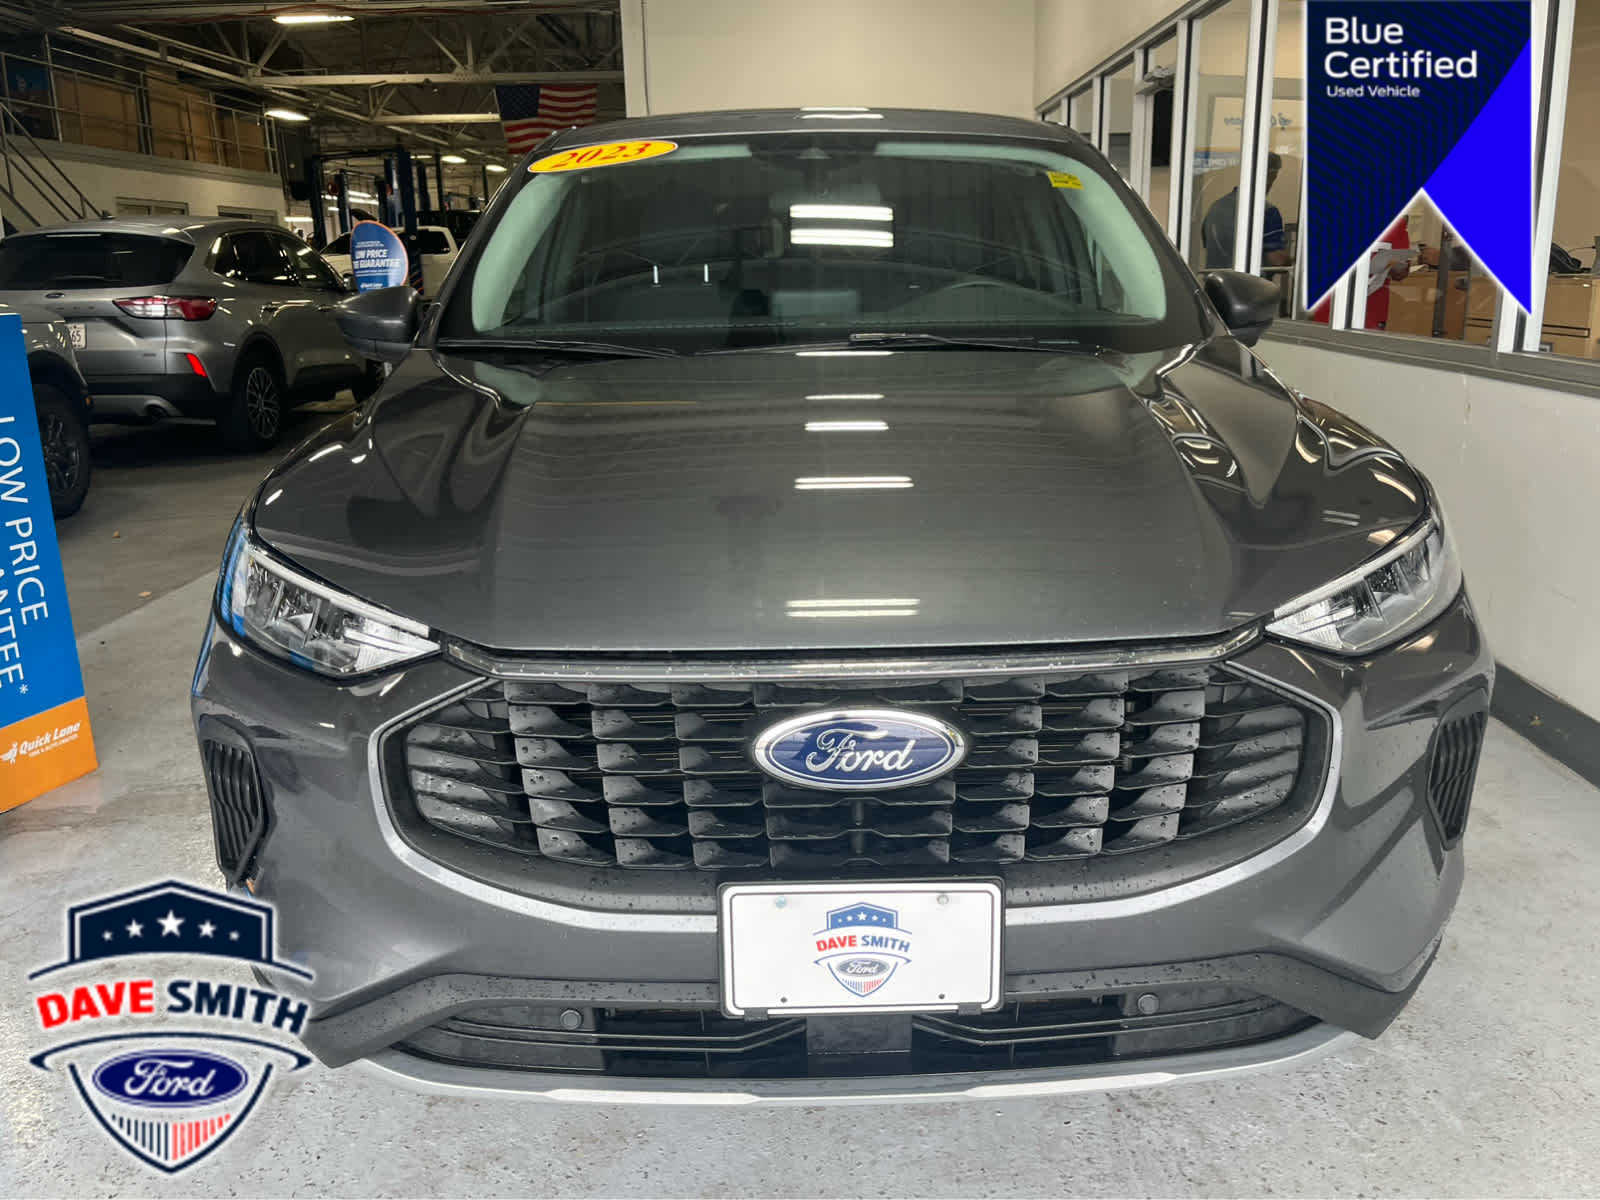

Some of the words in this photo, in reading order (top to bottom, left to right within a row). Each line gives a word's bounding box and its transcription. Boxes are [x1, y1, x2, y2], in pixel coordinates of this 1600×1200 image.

[552, 142, 652, 168] 2023
[5, 516, 48, 625] PRICE
[19, 731, 51, 756] Quick
[53, 721, 81, 741] Lane
[805, 728, 916, 772] Ford
[816, 935, 858, 952] DAVE
[861, 935, 910, 953] SMITH
